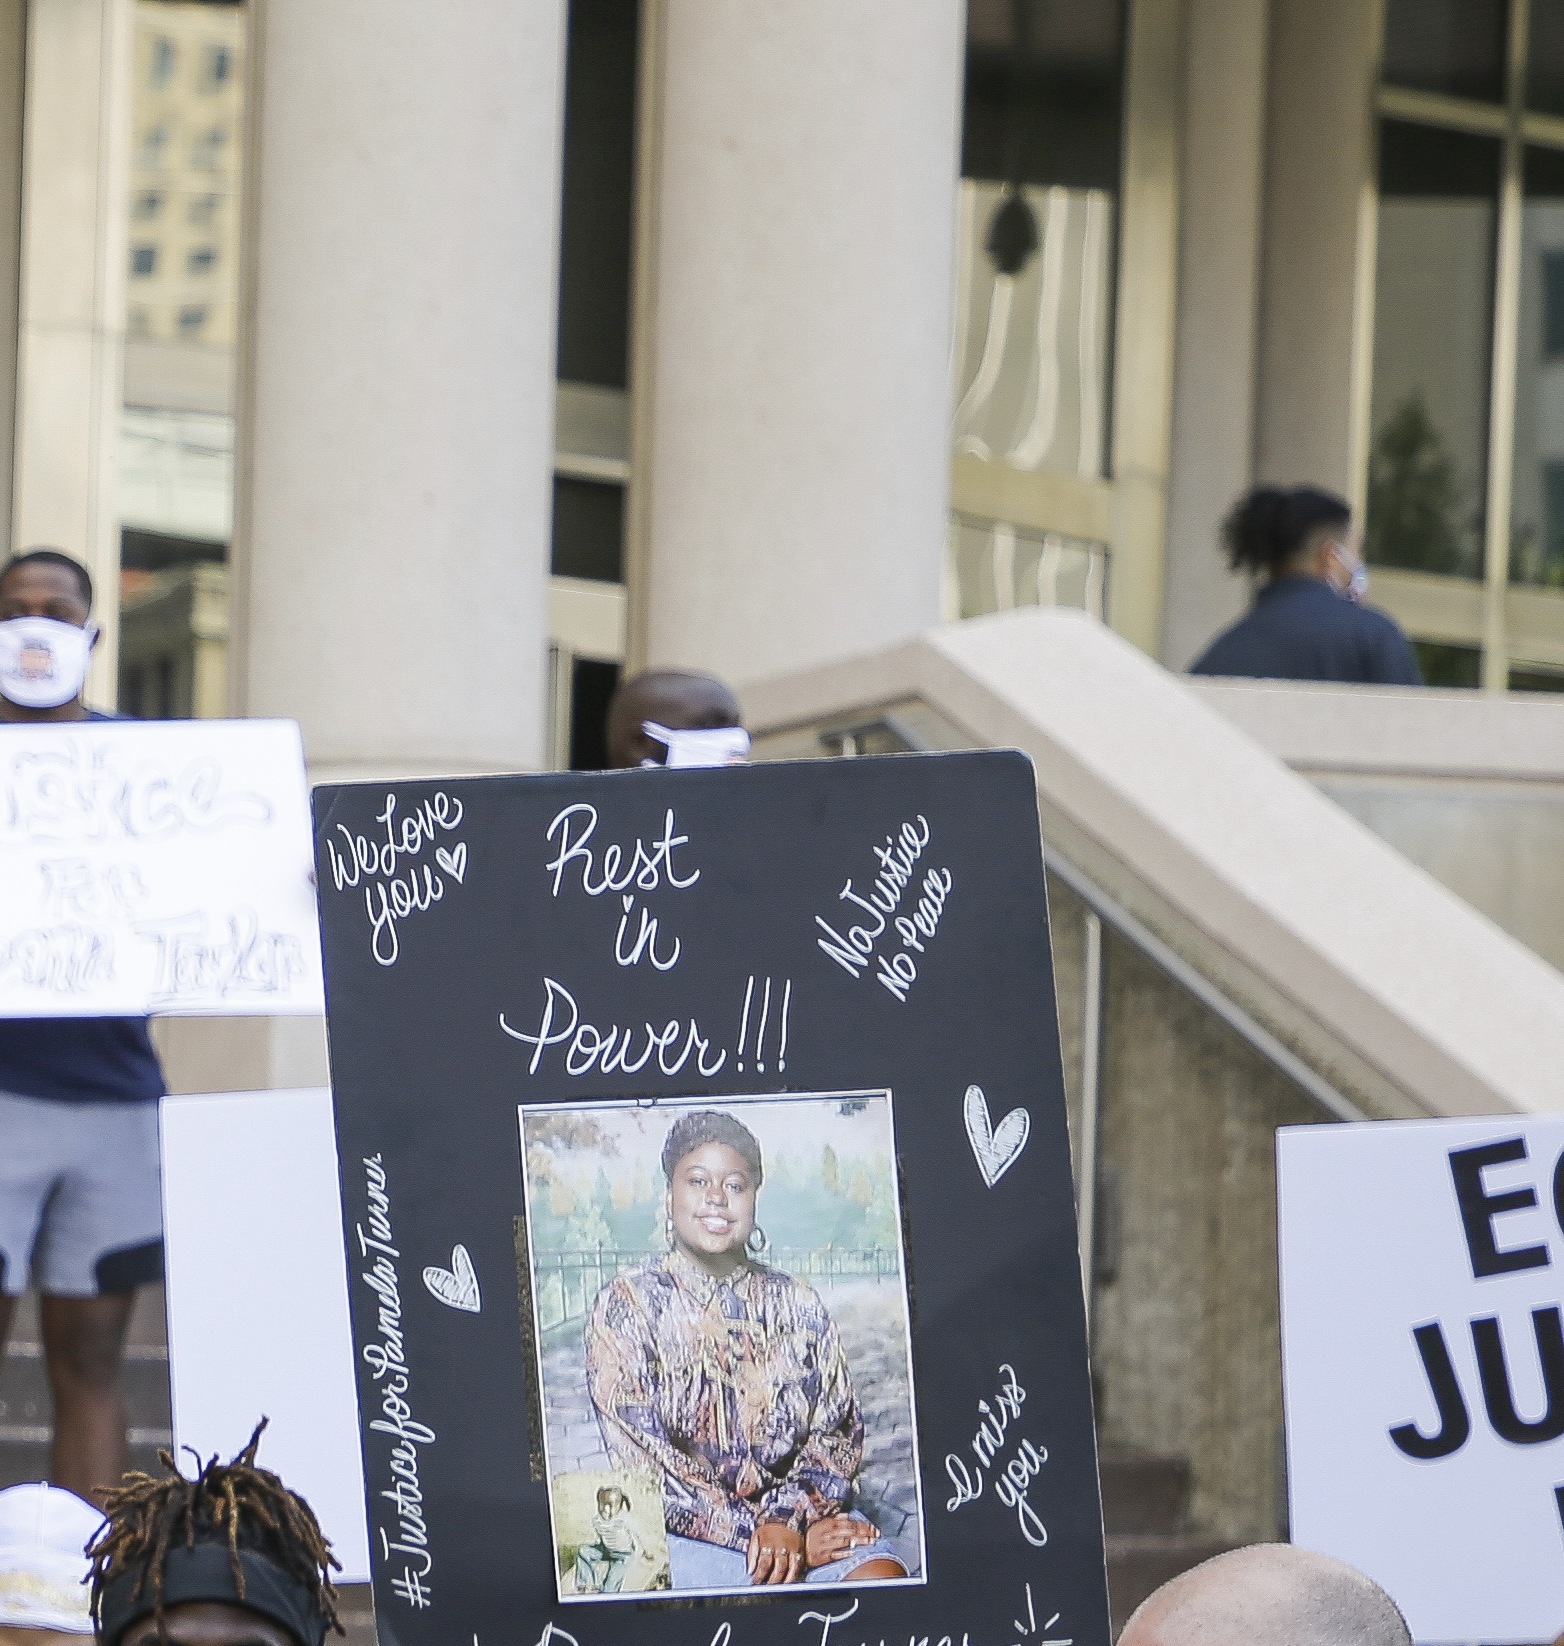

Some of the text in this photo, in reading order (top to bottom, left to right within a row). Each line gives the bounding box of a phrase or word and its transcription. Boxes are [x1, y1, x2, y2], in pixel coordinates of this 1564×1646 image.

[327, 791, 463, 890] We Love
[545, 802, 701, 898] Rest
[615, 895, 680, 970] in
[875, 866, 953, 1003] No Peace
